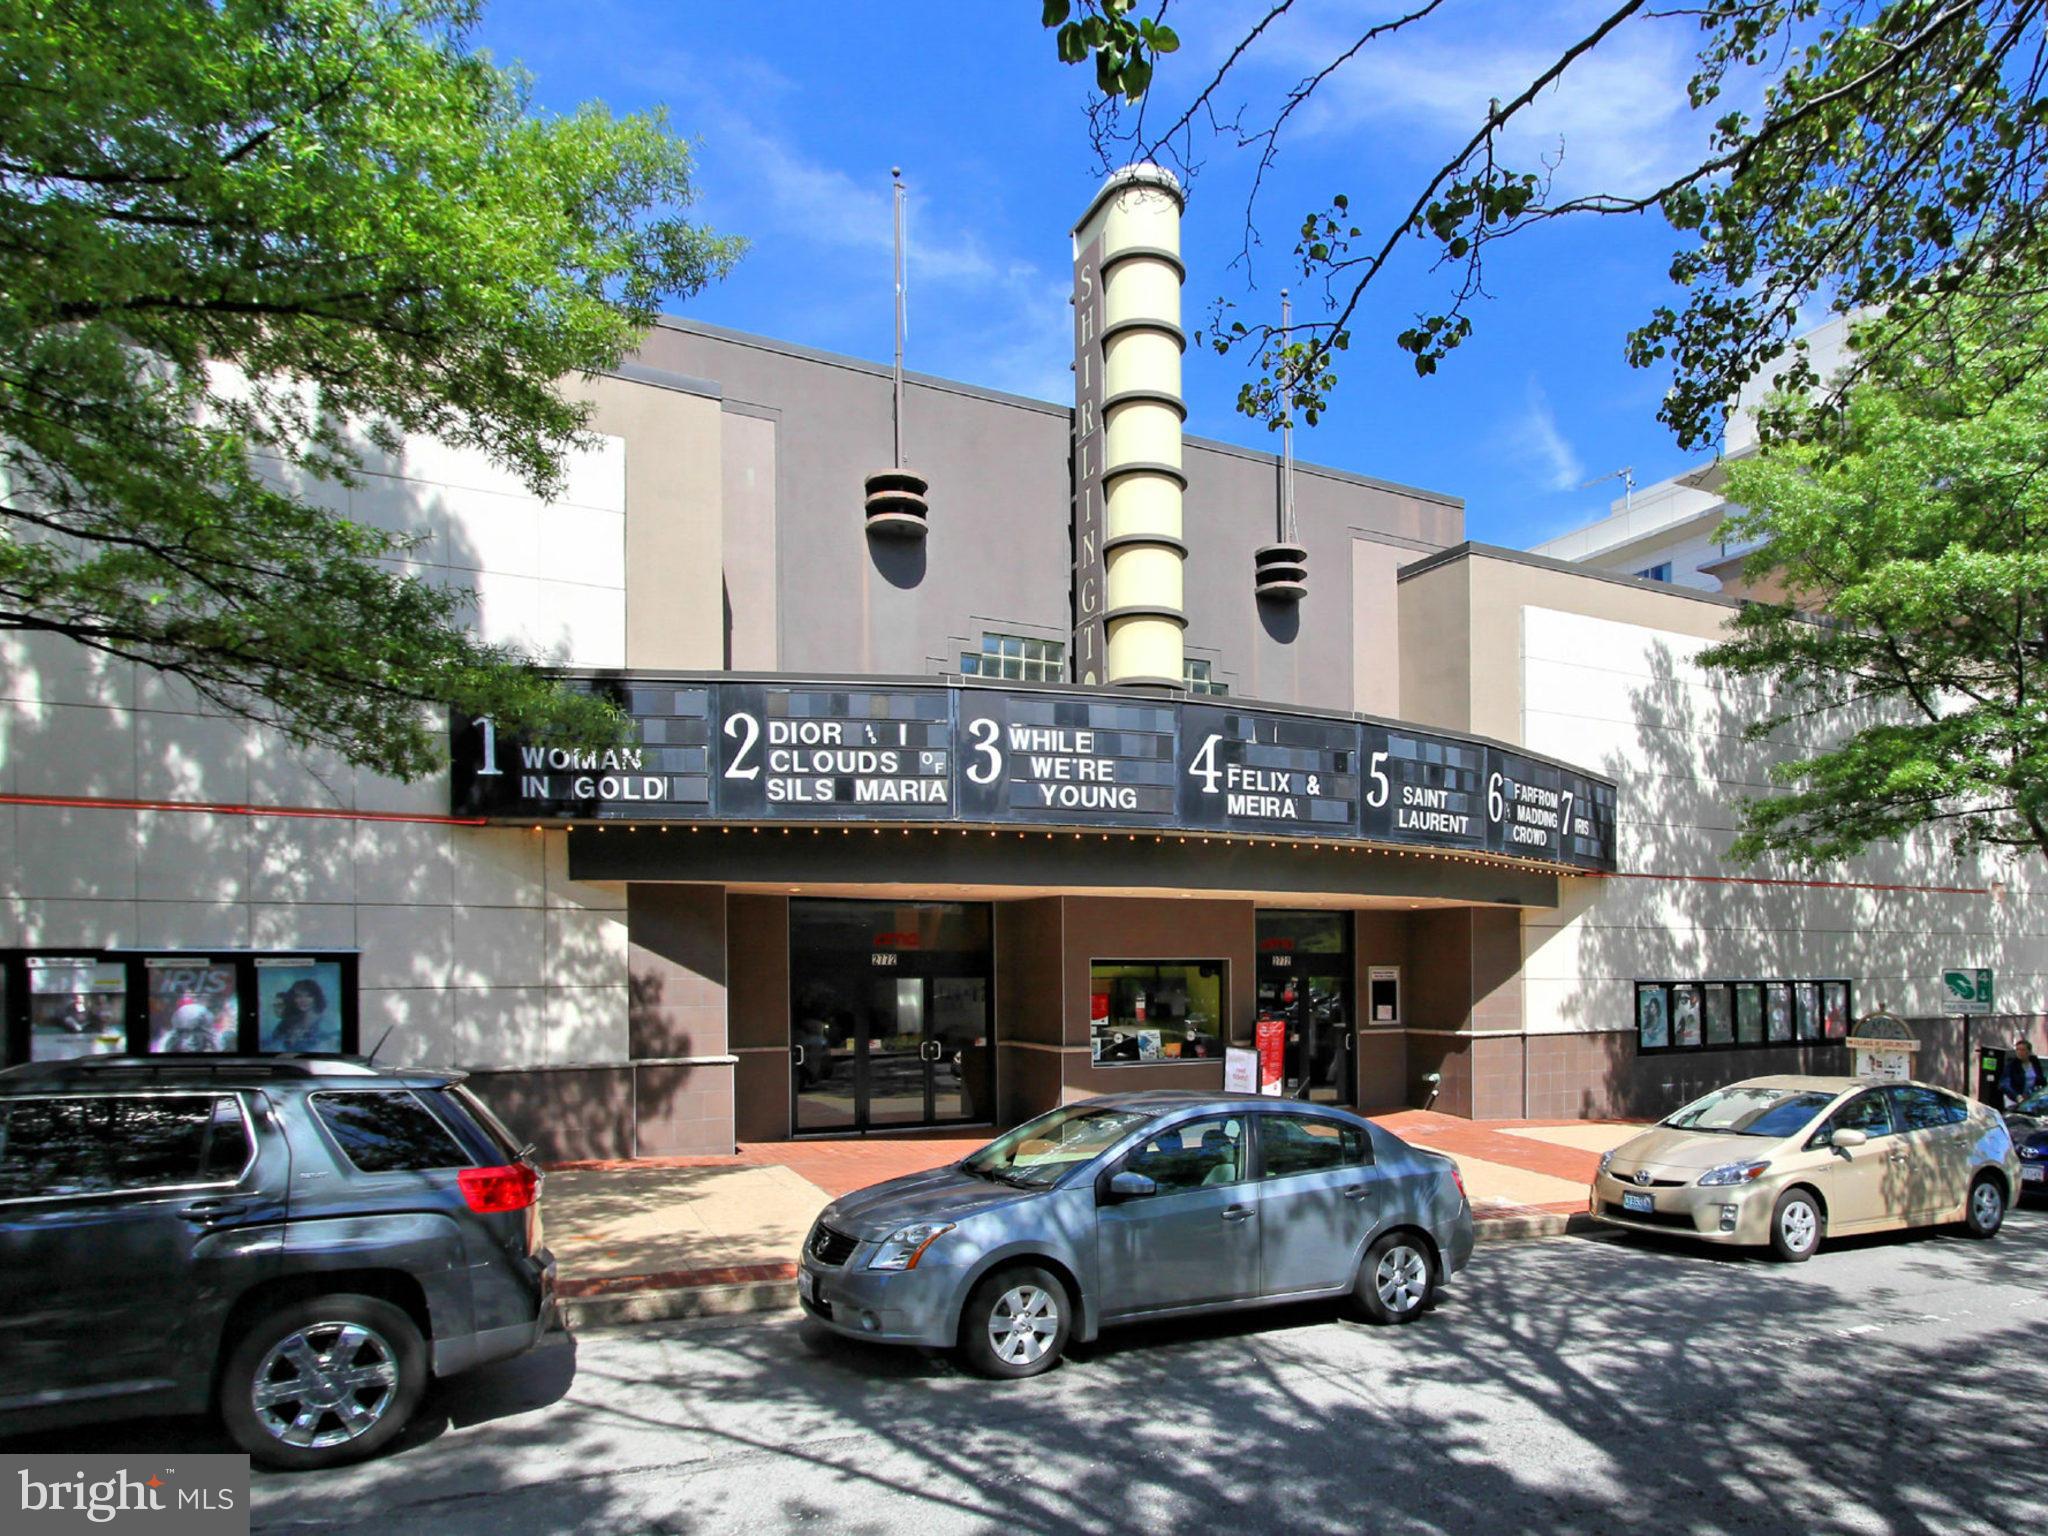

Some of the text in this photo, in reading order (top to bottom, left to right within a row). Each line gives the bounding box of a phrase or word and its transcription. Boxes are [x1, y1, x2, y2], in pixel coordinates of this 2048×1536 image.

[472, 713, 503, 776] 1
[724, 712, 760, 780] 2
[769, 721, 842, 745] DIOR
[899, 723, 907, 746] I
[1009, 727, 1092, 753] WHILE
[521, 746, 642, 770] WOMAN
[769, 751, 945, 774] CLOUDS OF
[966, 718, 1001, 784] 3
[1188, 734, 1223, 793] 4
[1030, 756, 1114, 781] WE'RE
[1366, 752, 1389, 808] 5
[522, 776, 664, 800] IN GOLD
[767, 779, 947, 803] SILS MARIA
[1227, 769, 1320, 796] FELIX &
[1040, 783, 1137, 809] YOUNG
[1227, 793, 1297, 818] MEIRA
[1403, 786, 1448, 809] SAINT
[1488, 772, 1503, 823] 6
[1514, 783, 1558, 809] FARFROM
[1398, 808, 1469, 835] LAURENT
[1516, 805, 1558, 828] MADDING
[1561, 790, 1574, 835] 7
[1513, 825, 1547, 846] CROWD
[872, 954, 897, 965] 2772
[161, 970, 229, 993] IRIS
